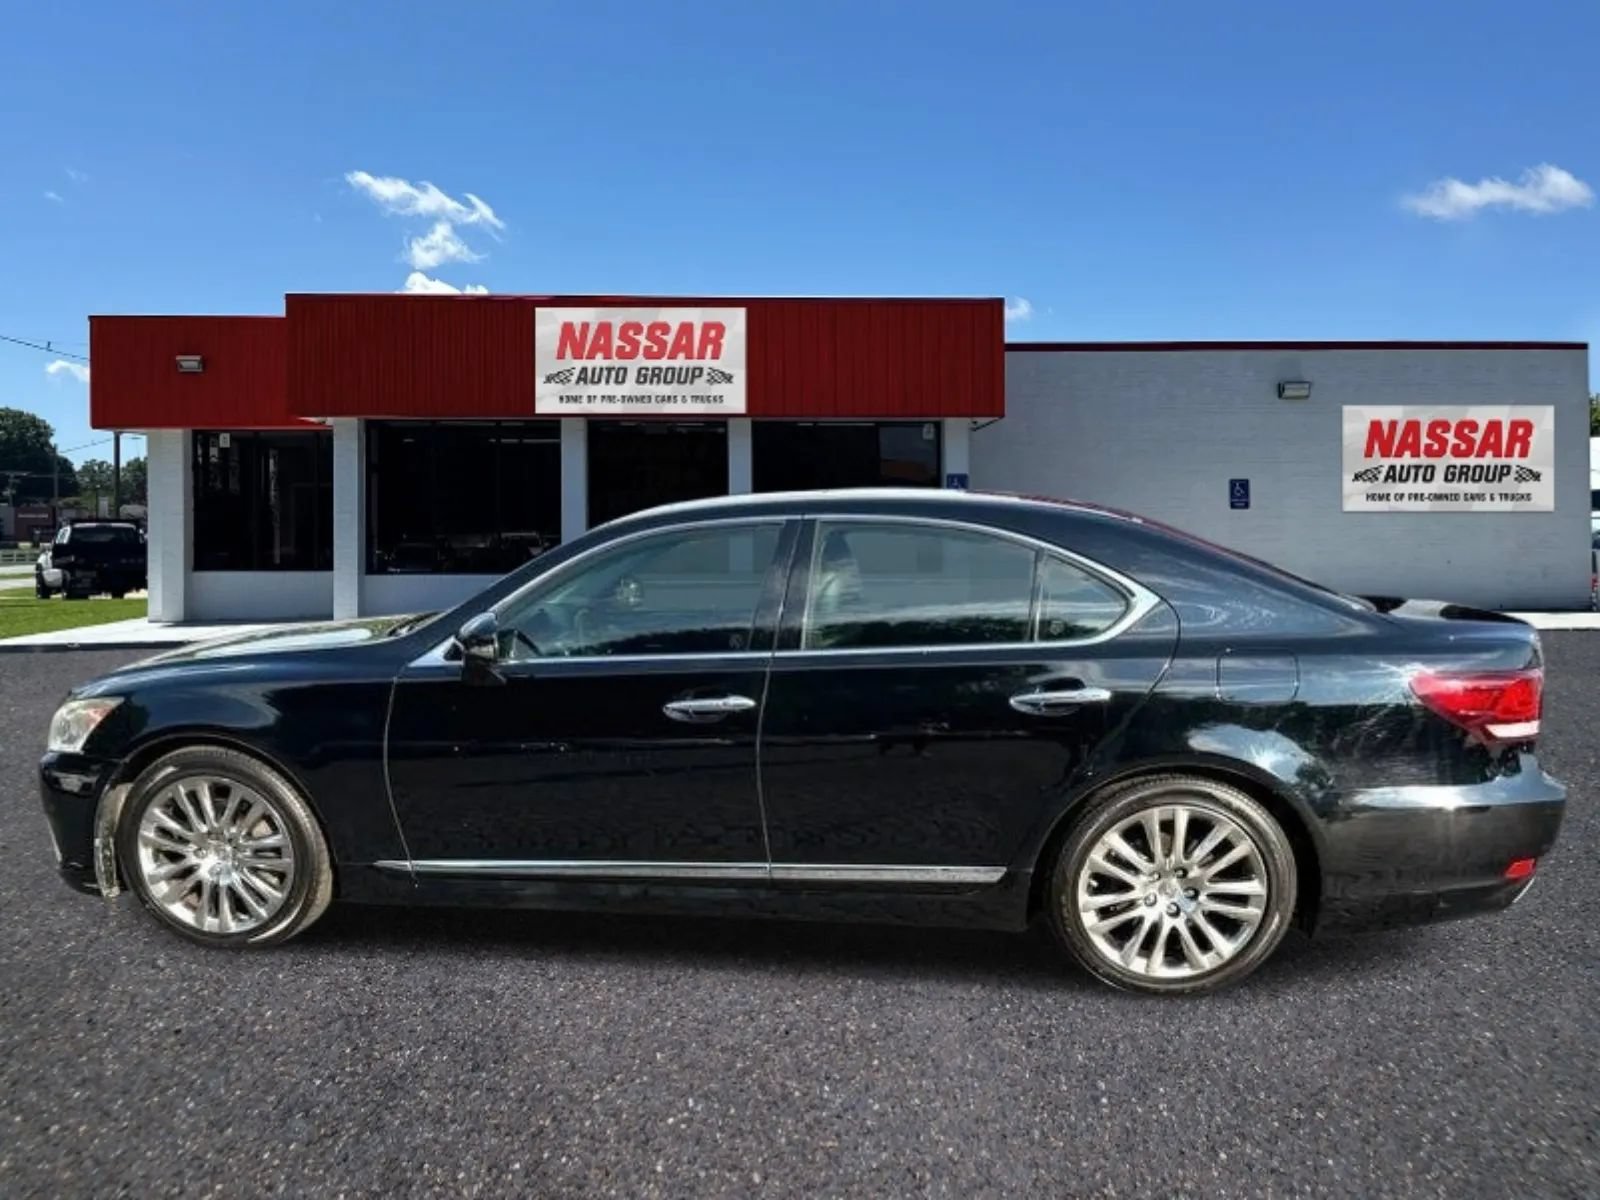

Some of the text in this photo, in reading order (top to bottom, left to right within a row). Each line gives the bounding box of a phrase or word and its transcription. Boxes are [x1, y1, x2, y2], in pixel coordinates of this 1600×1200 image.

[555, 321, 726, 360] NASSAR
[575, 366, 704, 385] AUTO GROUP
[690, 394, 724, 404] TRUCKS
[1364, 419, 1534, 459] NASSAR
[1383, 464, 1512, 484] AUTO GROUP
